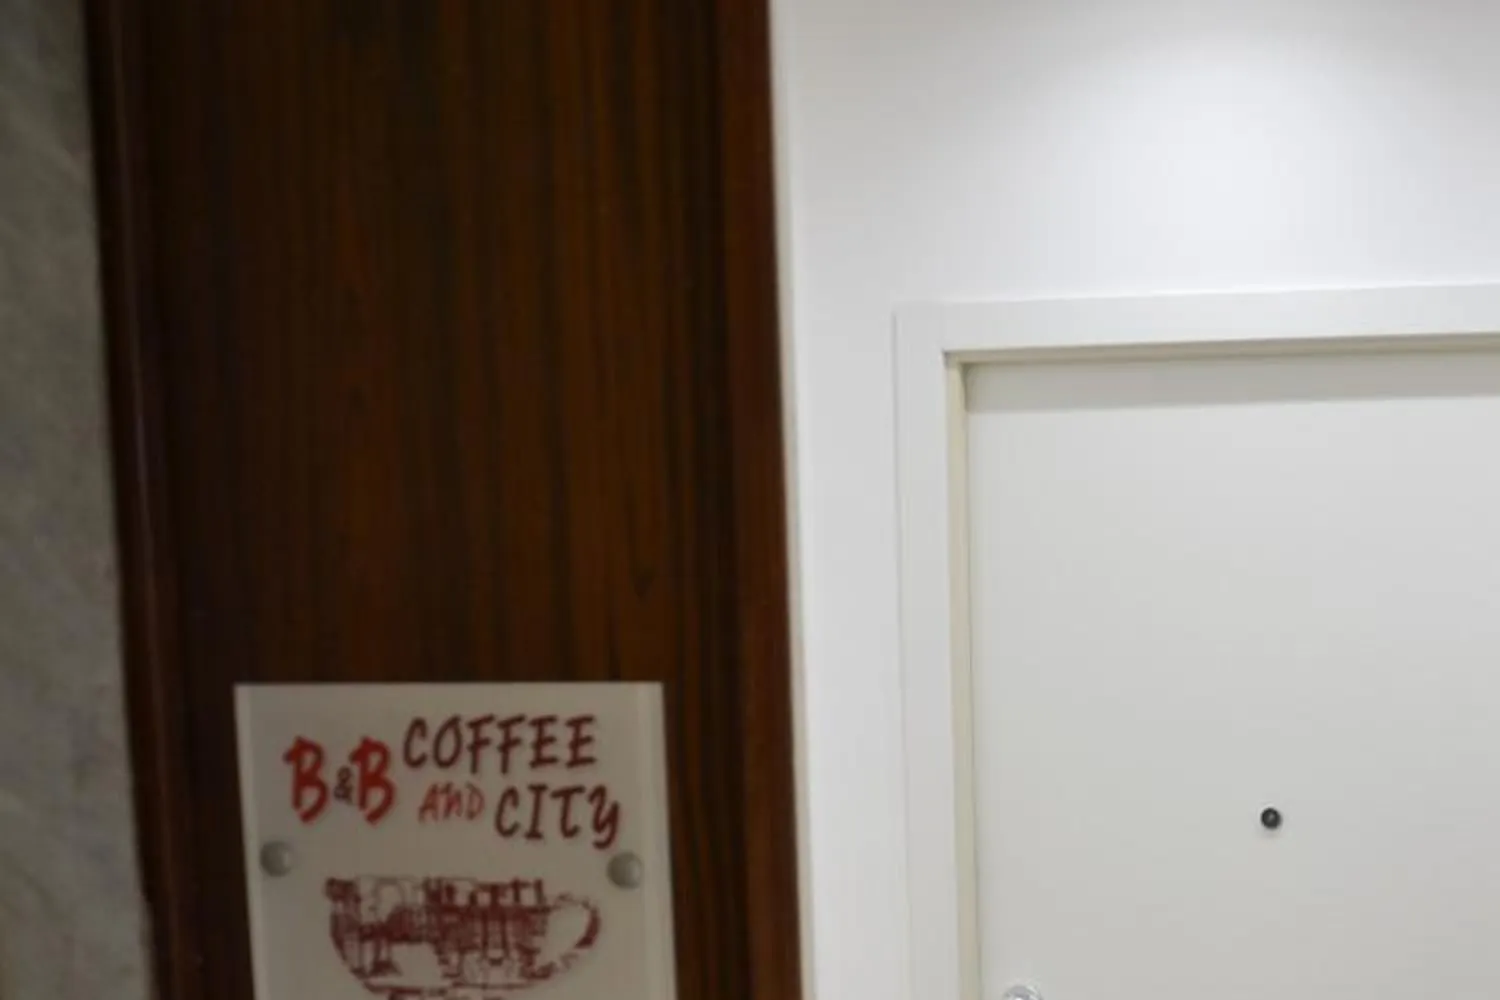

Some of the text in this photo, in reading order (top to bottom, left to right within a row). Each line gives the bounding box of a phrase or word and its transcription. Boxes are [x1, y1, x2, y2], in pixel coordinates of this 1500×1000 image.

[283, 714, 597, 825] B&B COFFEE
[418, 781, 486, 823] AND
